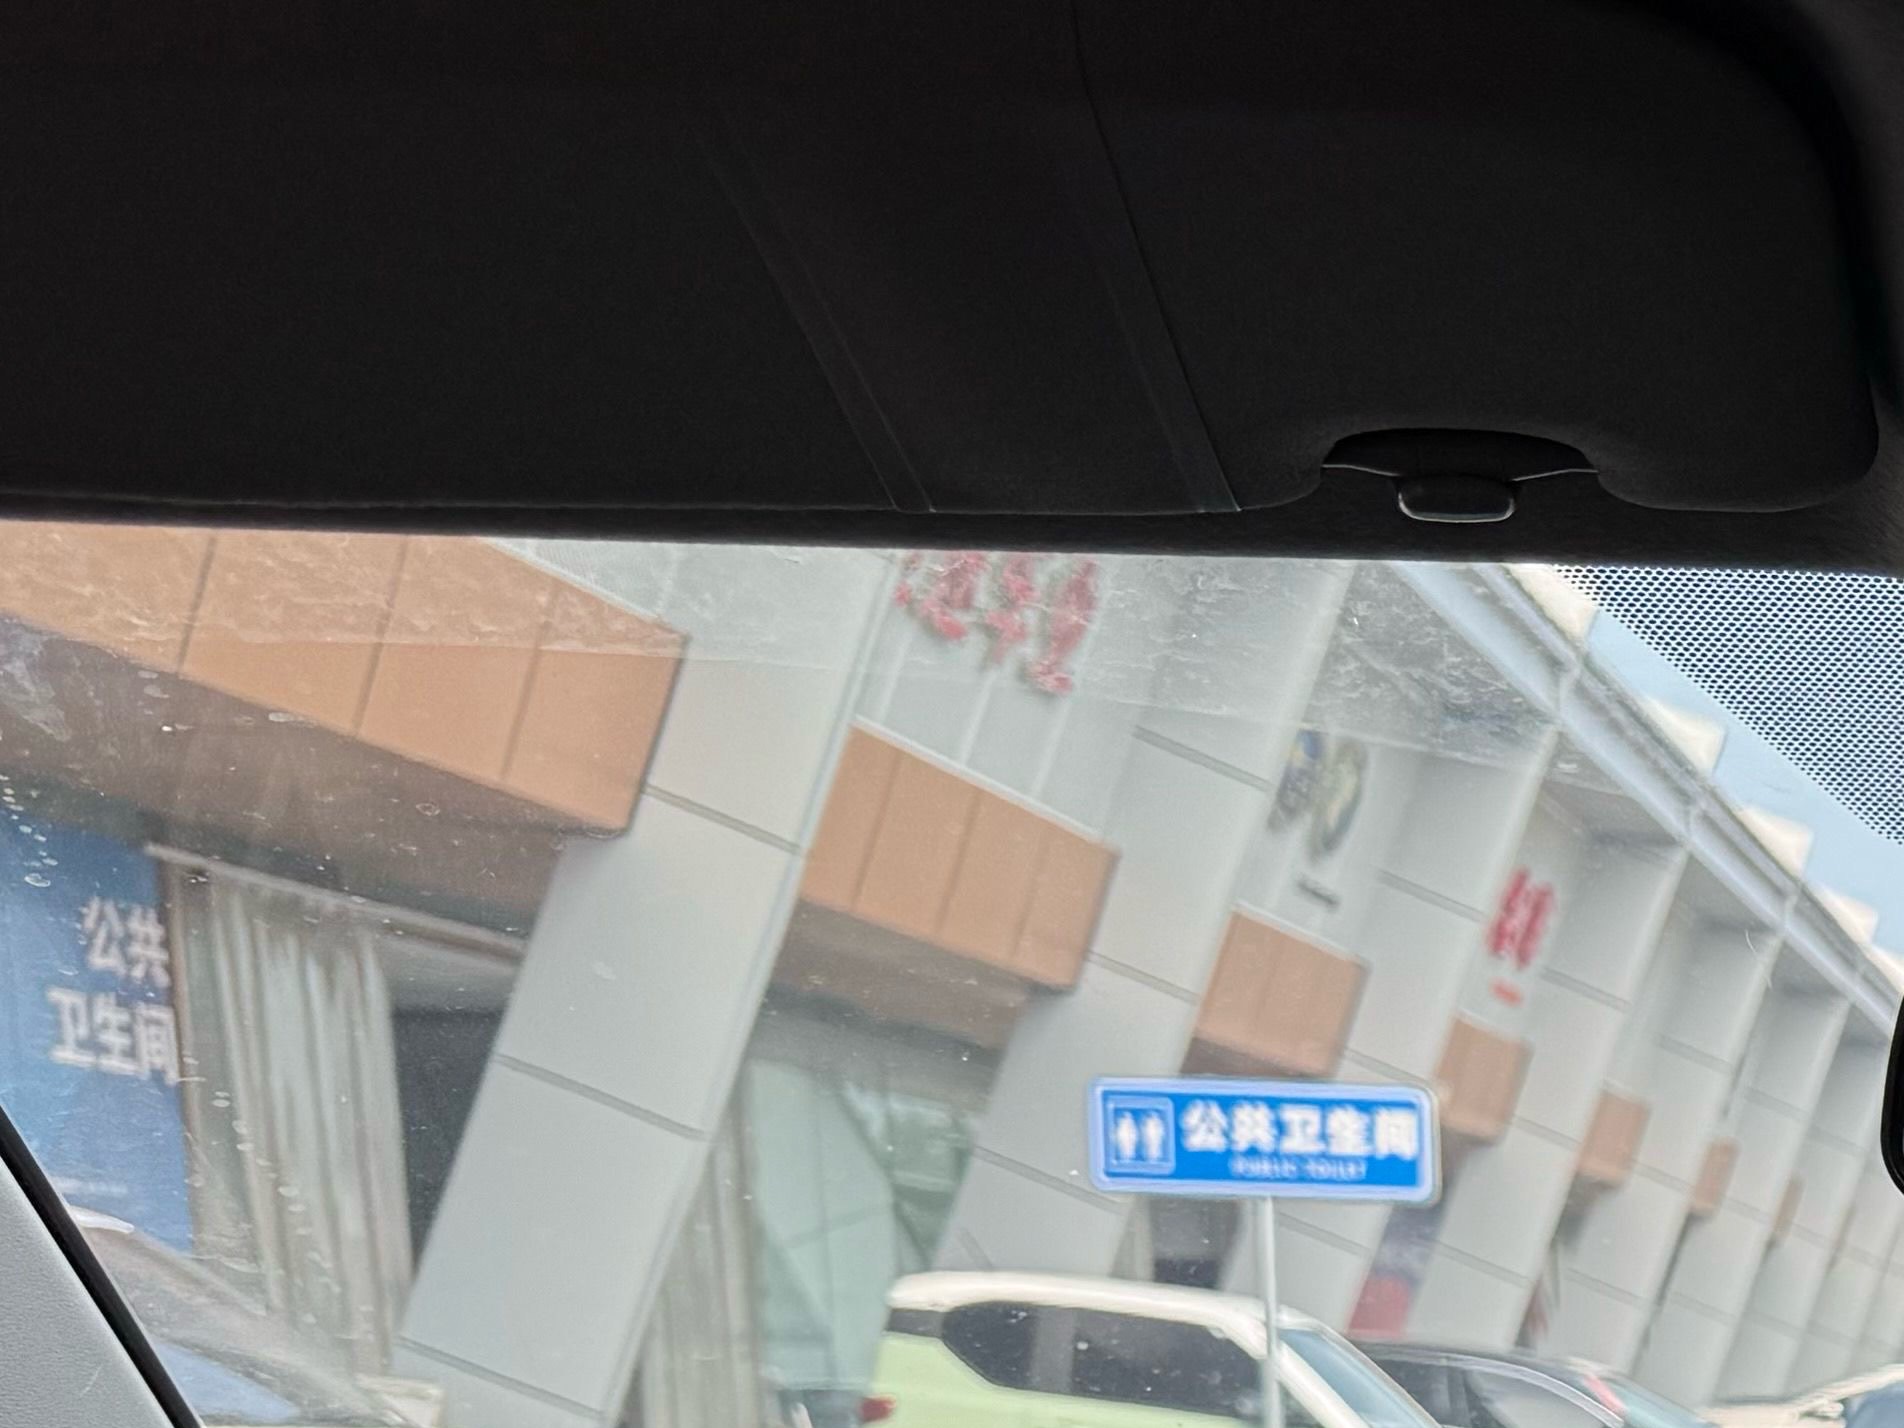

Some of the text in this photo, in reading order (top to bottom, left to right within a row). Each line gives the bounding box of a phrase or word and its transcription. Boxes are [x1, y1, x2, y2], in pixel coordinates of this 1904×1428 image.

[82, 896, 171, 988] 公共
[45, 985, 180, 1086] 卫生间
[1179, 1098, 1419, 1160] 公共卫生间
